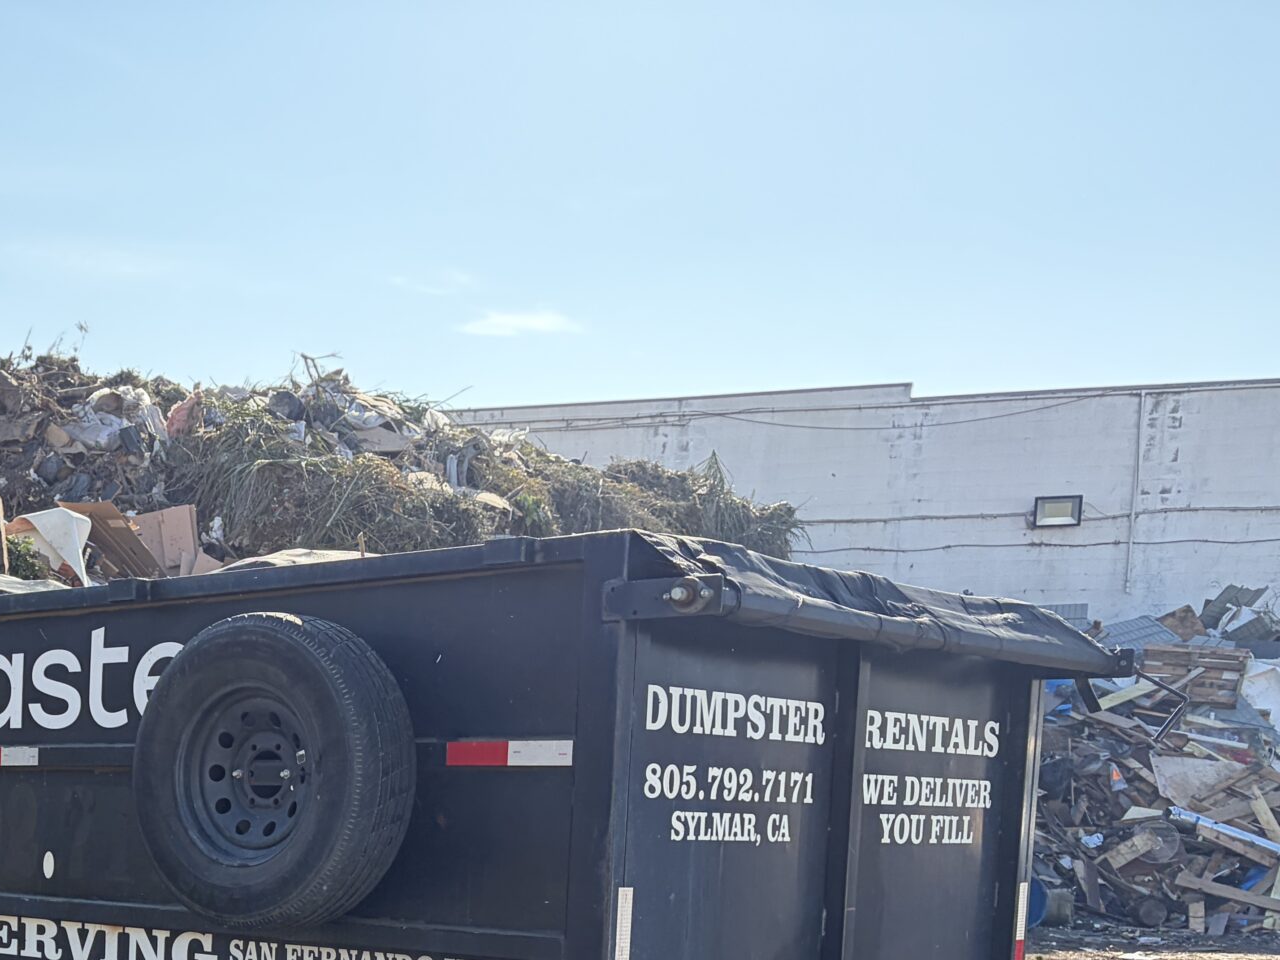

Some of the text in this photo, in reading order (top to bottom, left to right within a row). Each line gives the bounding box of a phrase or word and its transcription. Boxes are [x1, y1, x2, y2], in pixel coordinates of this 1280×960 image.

[645, 683, 1000, 758] DUMPSTER RENTALS
[643, 762, 814, 804] 805.792.7171
[862, 773, 992, 809] WE DELIVER
[670, 810, 791, 847] SYLMAR, CA
[879, 812, 974, 845] YOU FILL
